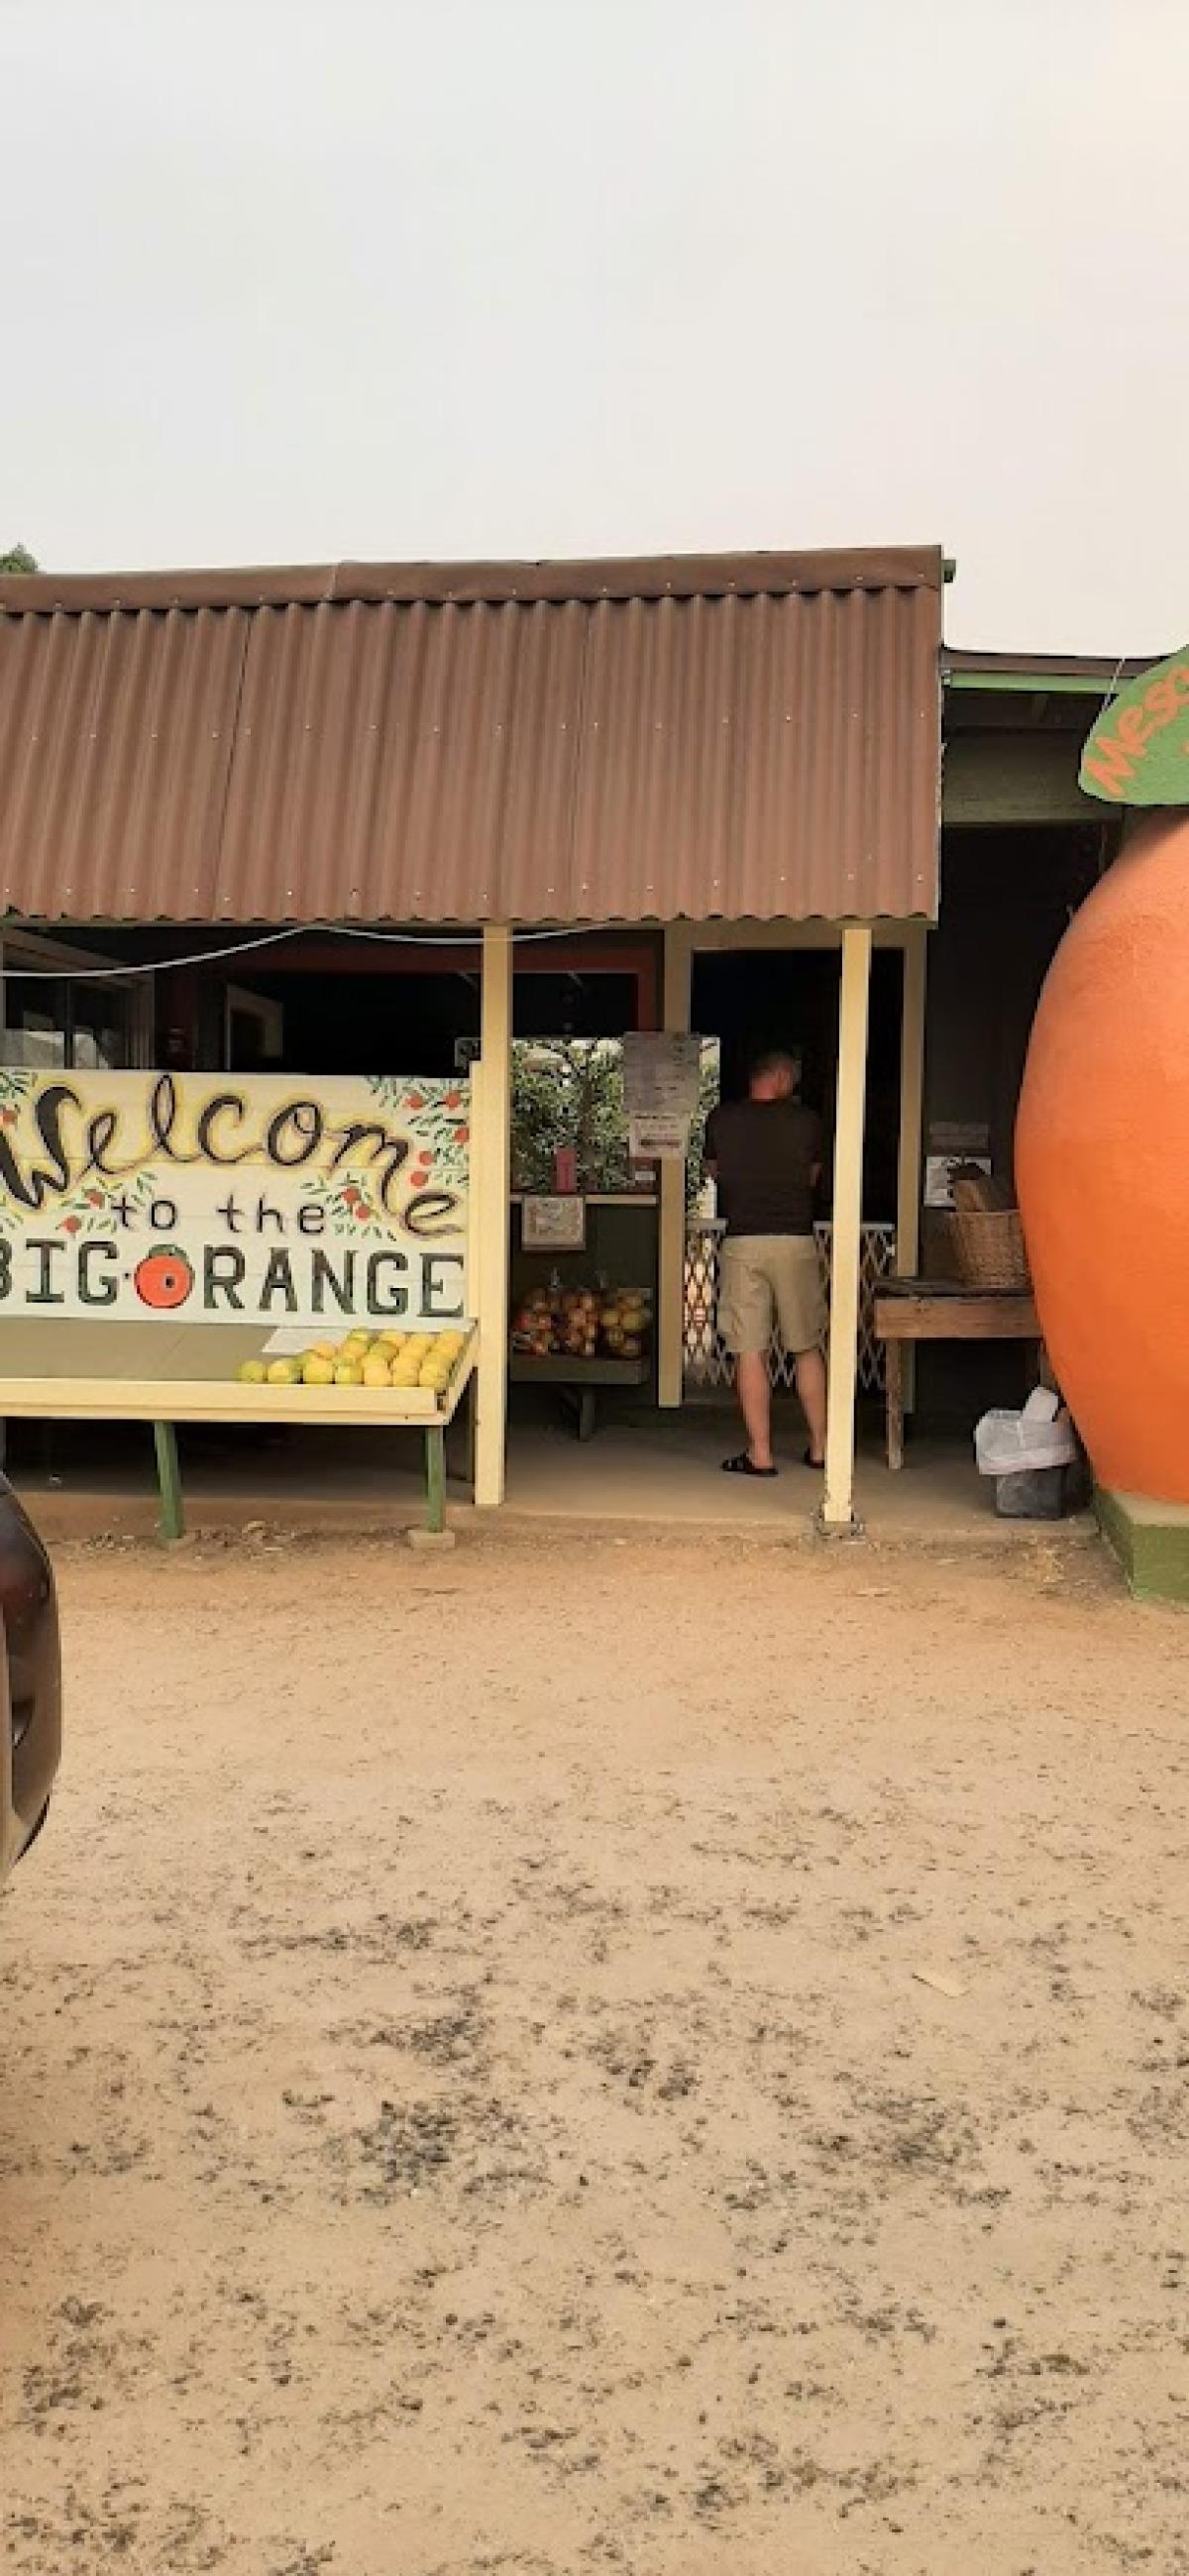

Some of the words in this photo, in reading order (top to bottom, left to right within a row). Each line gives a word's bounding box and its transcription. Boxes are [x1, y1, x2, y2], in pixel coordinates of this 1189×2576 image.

[0, 1074, 465, 1239] Welcome
[111, 1194, 177, 1233] to
[216, 1194, 325, 1234] the
